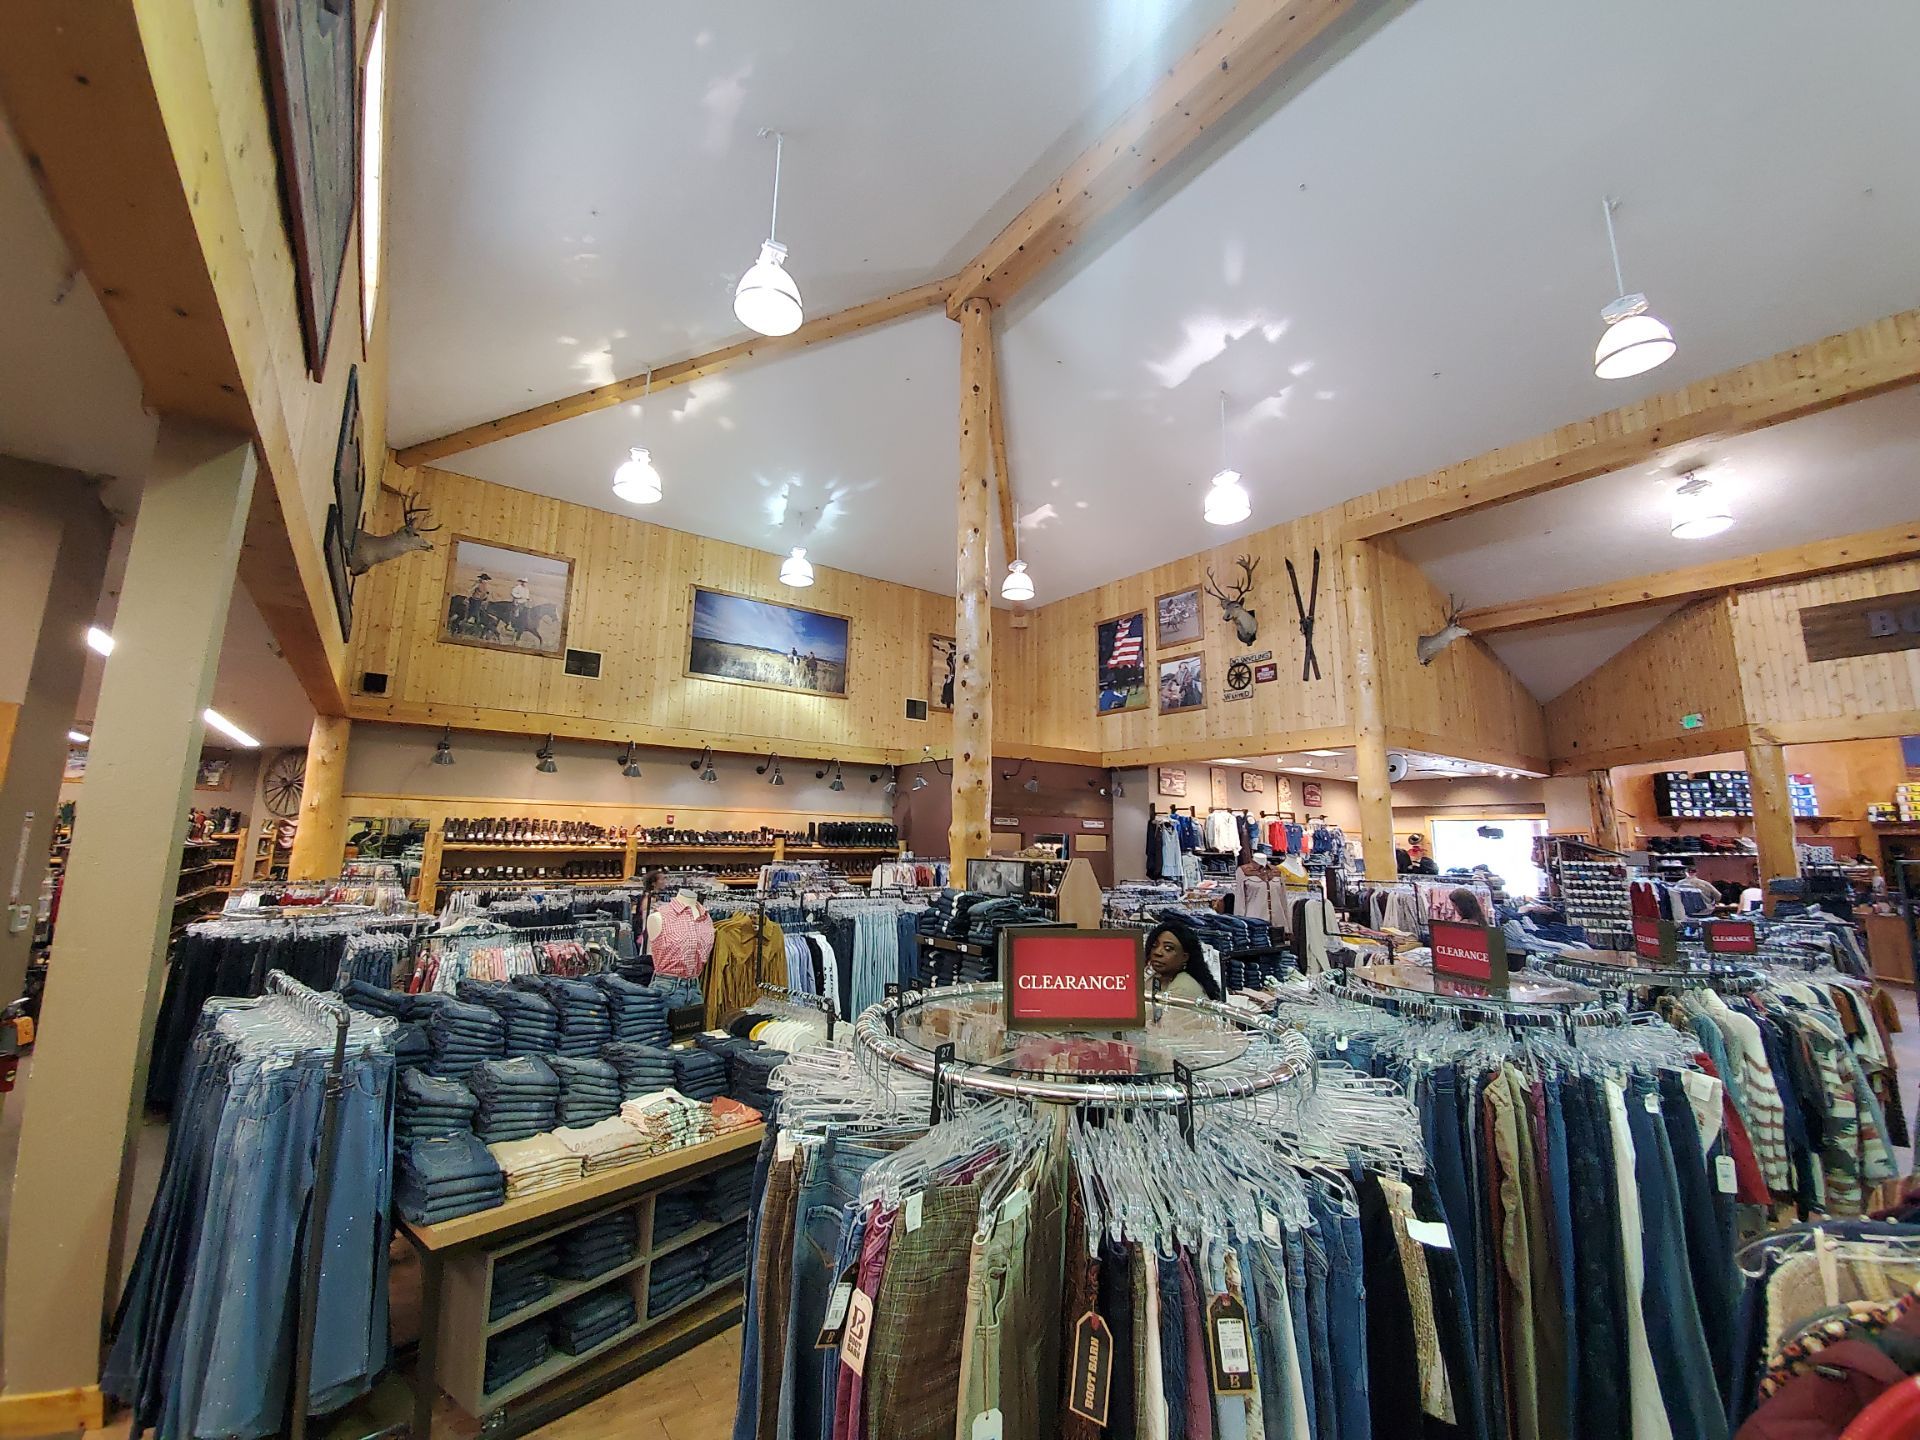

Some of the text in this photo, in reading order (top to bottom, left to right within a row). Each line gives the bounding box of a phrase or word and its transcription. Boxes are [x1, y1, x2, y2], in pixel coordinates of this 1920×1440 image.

[1436, 945, 1490, 962] CLEARANCE
[888, 985, 898, 993] 26
[1018, 974, 1128, 990] CLEARANCE
[941, 1046, 951, 1058] 27
[1084, 1336, 1099, 1410] BOOT BARN
[1230, 1374, 1241, 1389] B
